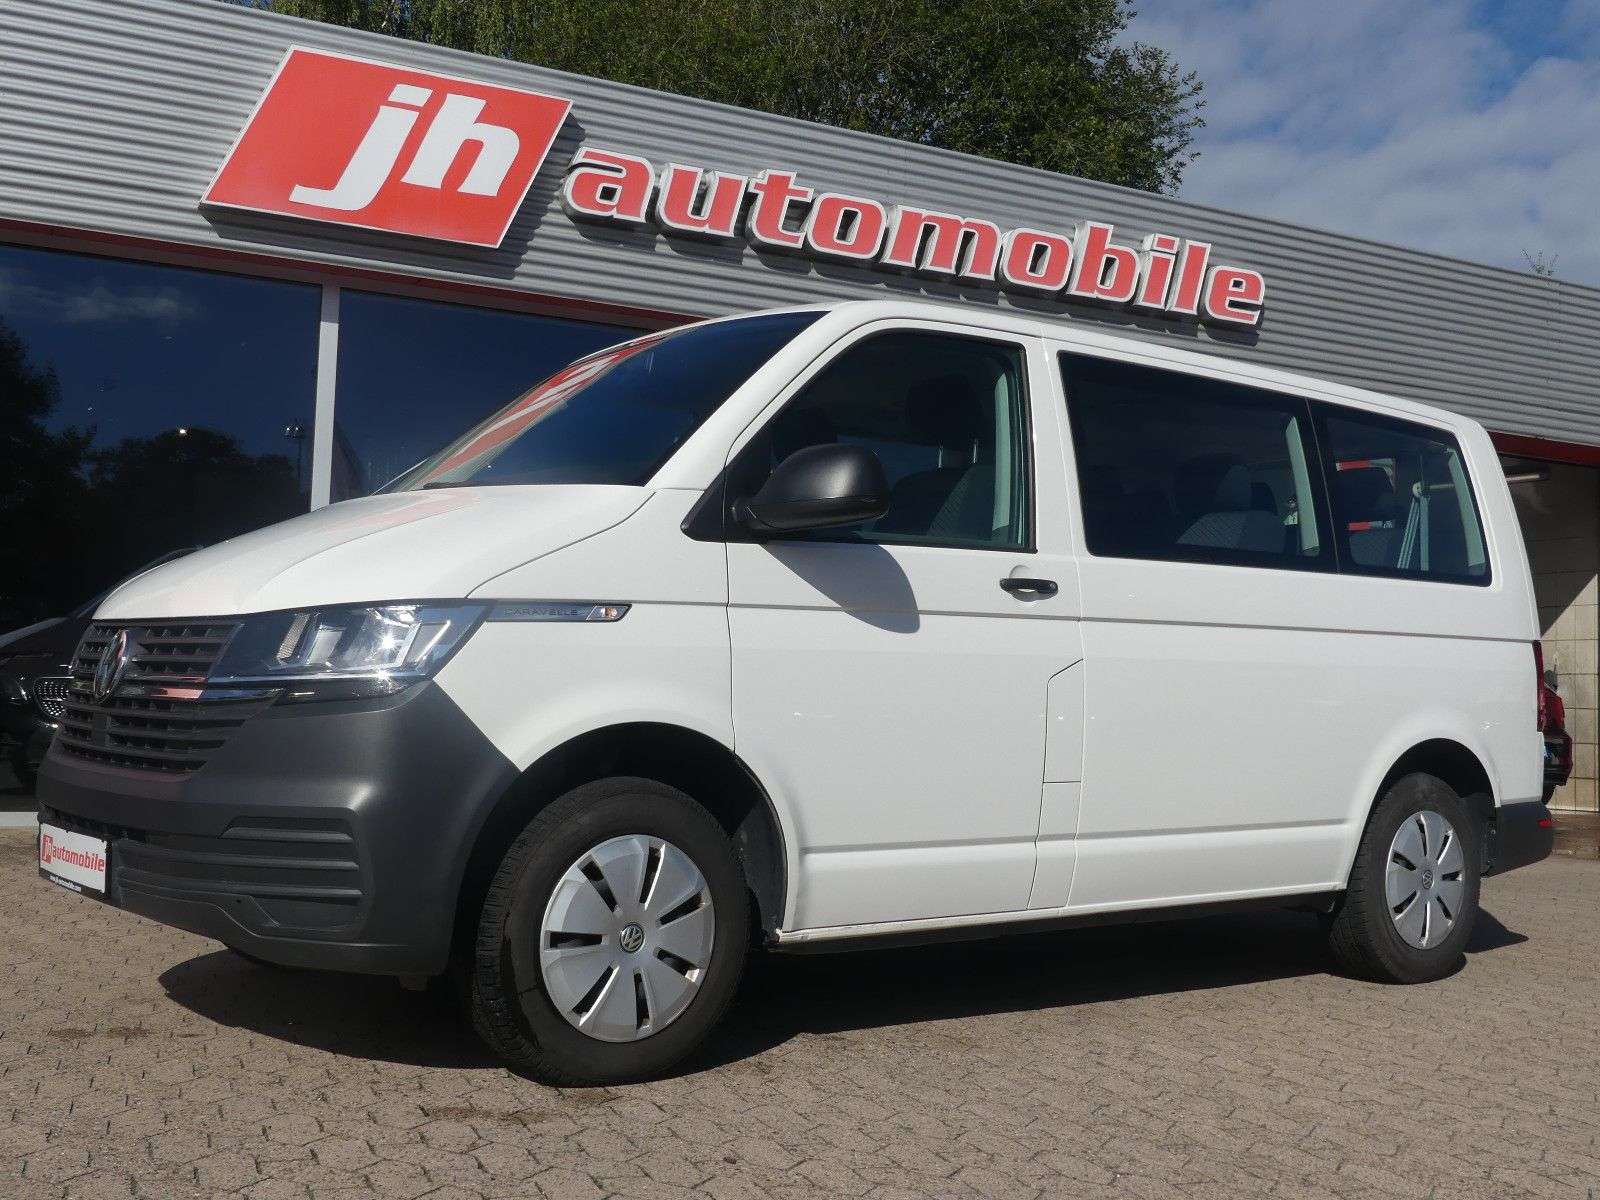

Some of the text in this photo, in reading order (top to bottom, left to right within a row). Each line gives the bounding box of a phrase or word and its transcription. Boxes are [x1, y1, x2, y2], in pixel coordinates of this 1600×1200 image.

[289, 83, 1267, 327] jh automobile
[52, 845, 105, 872] automobile
[620, 923, 644, 952] VW
